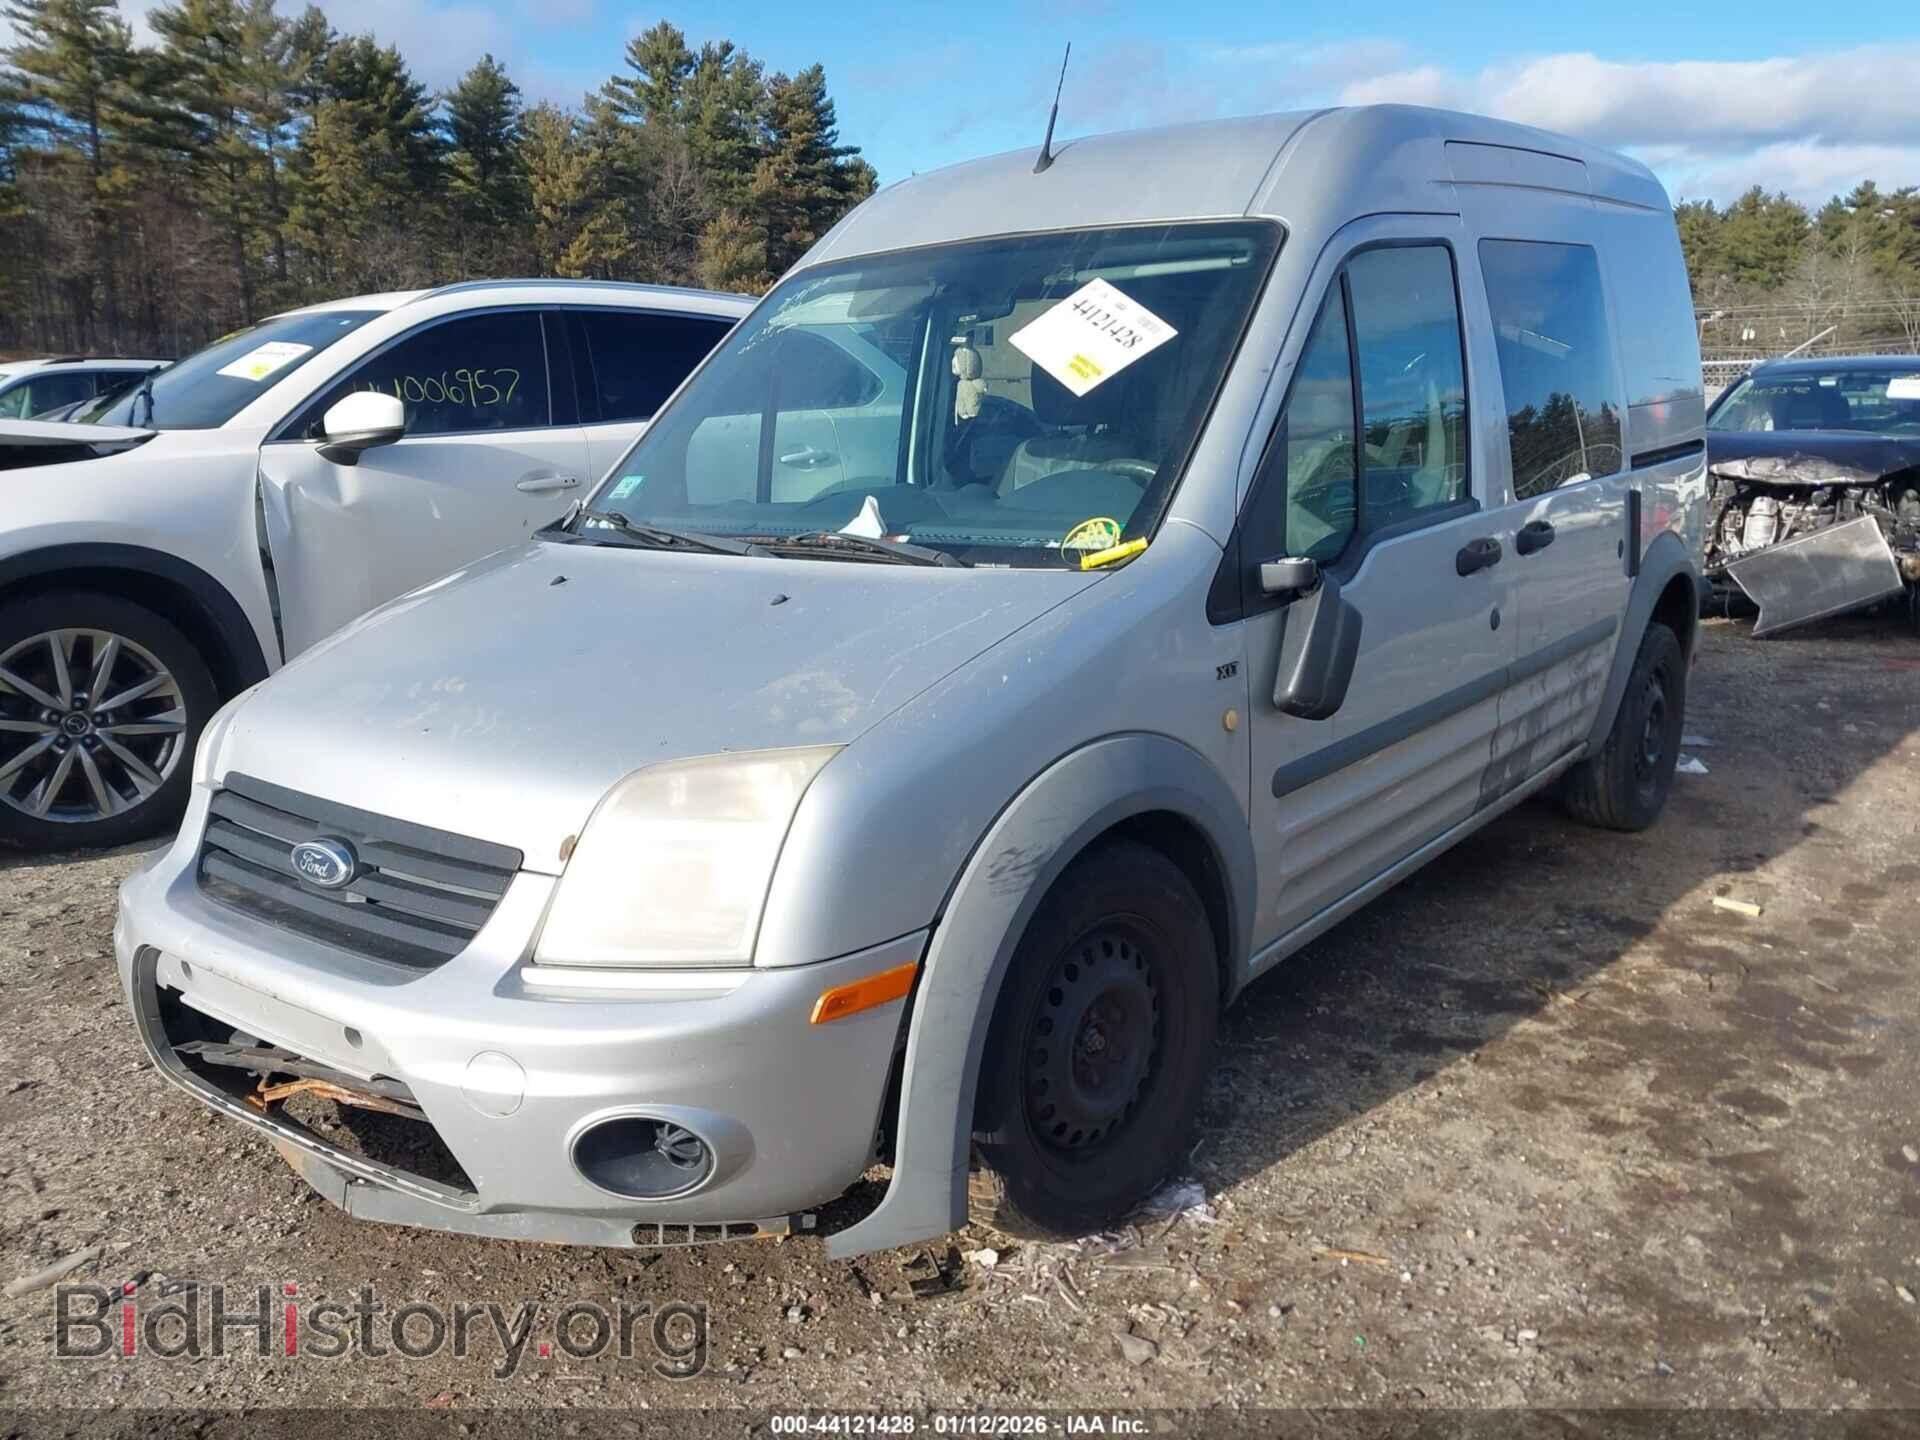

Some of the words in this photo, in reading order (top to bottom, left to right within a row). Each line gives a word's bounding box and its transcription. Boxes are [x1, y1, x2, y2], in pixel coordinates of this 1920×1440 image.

[1073, 299, 1143, 349] 44121428
[353, 368, 520, 409] 006957
[1216, 661, 1240, 681] XLT
[300, 850, 330, 878] Ford
